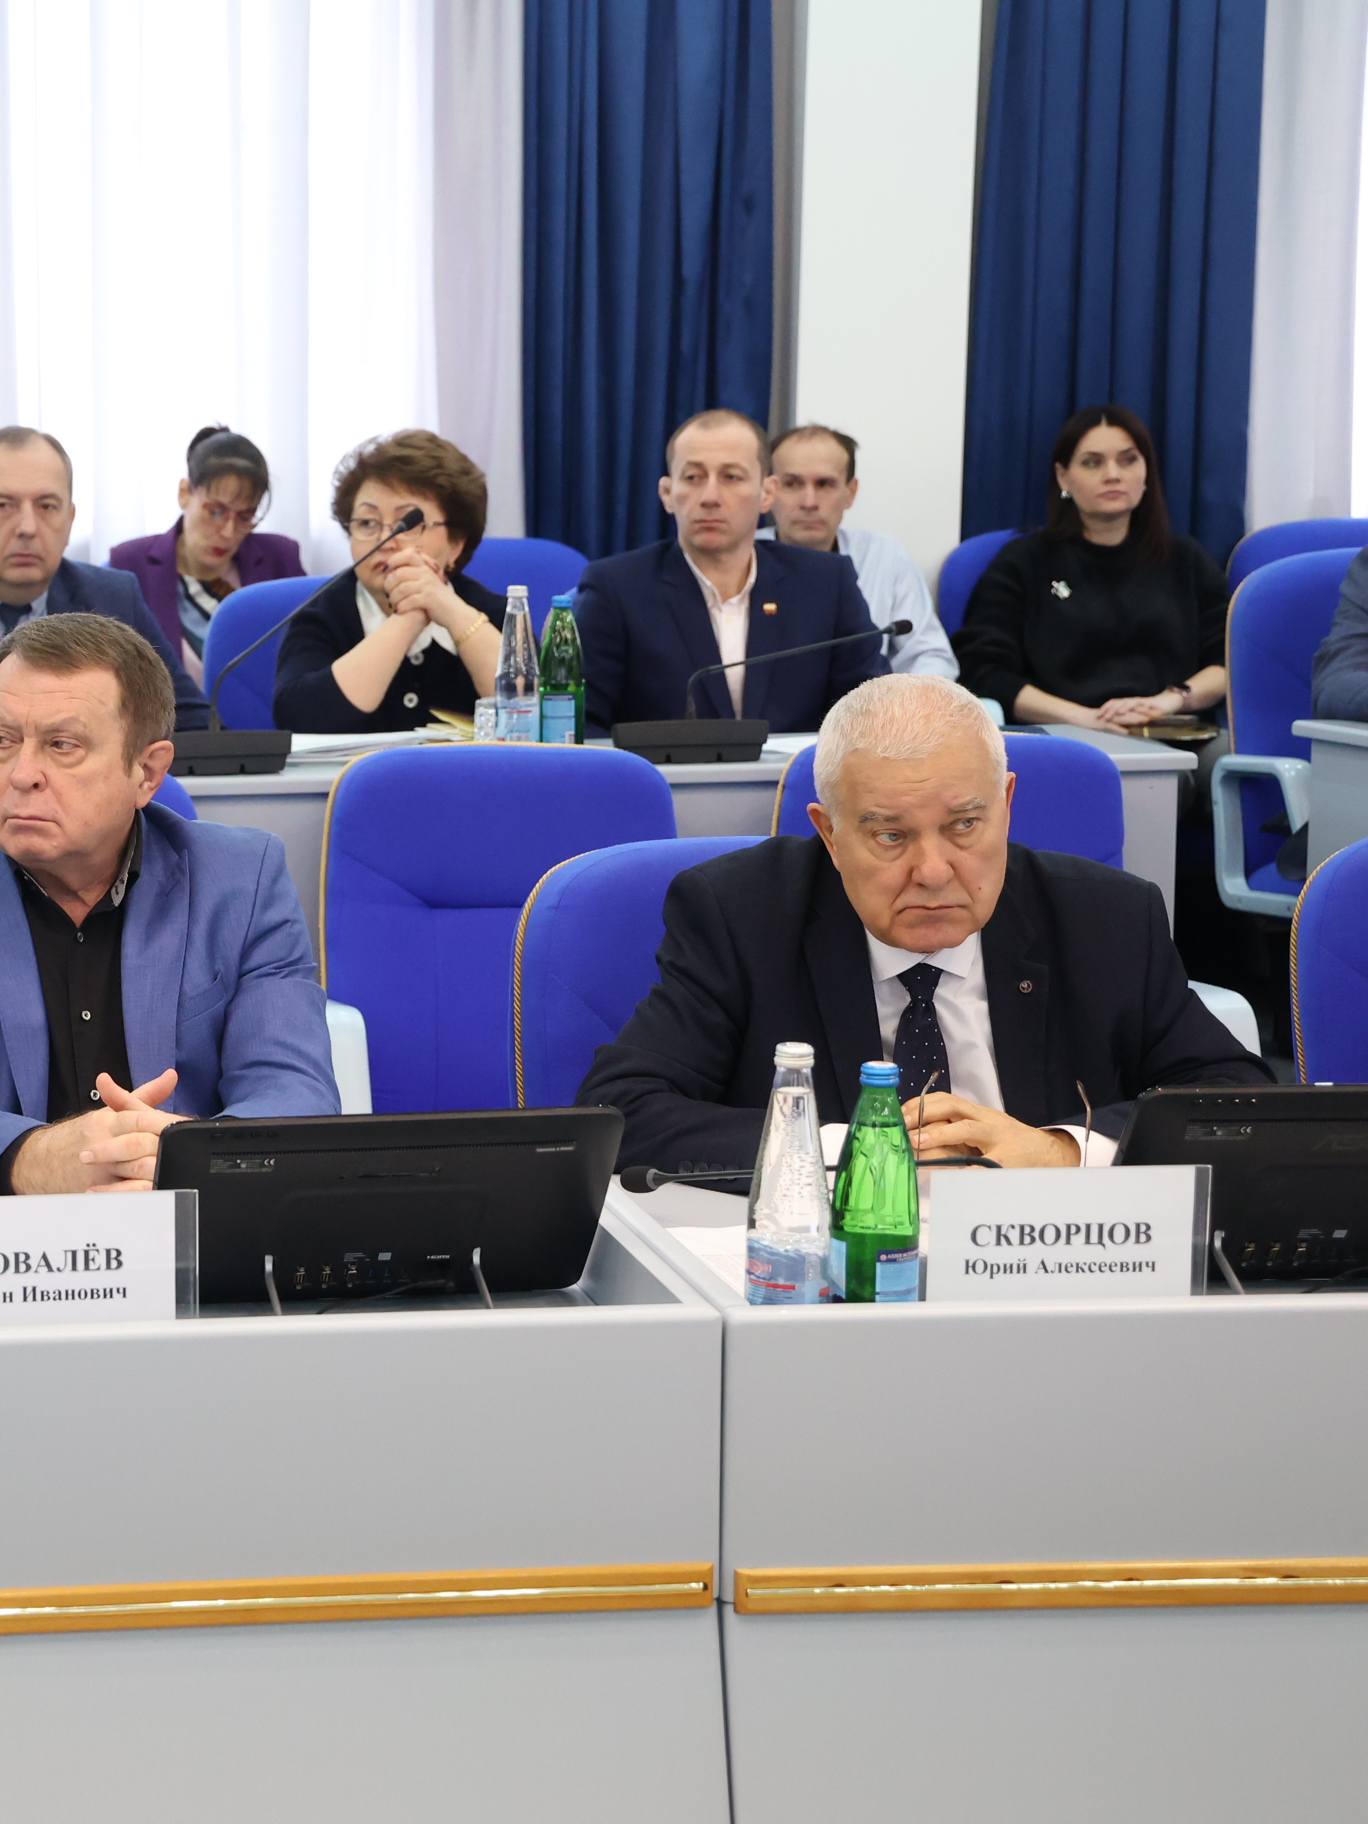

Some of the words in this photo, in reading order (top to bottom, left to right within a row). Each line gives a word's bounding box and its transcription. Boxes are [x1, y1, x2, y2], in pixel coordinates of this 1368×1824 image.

[970, 1221, 1152, 1250] СКВОРЦОВ
[964, 1258, 1027, 1279] Юрий
[1034, 1258, 1156, 1275] Алексеевич
[21, 1286, 127, 1303] Иванович
